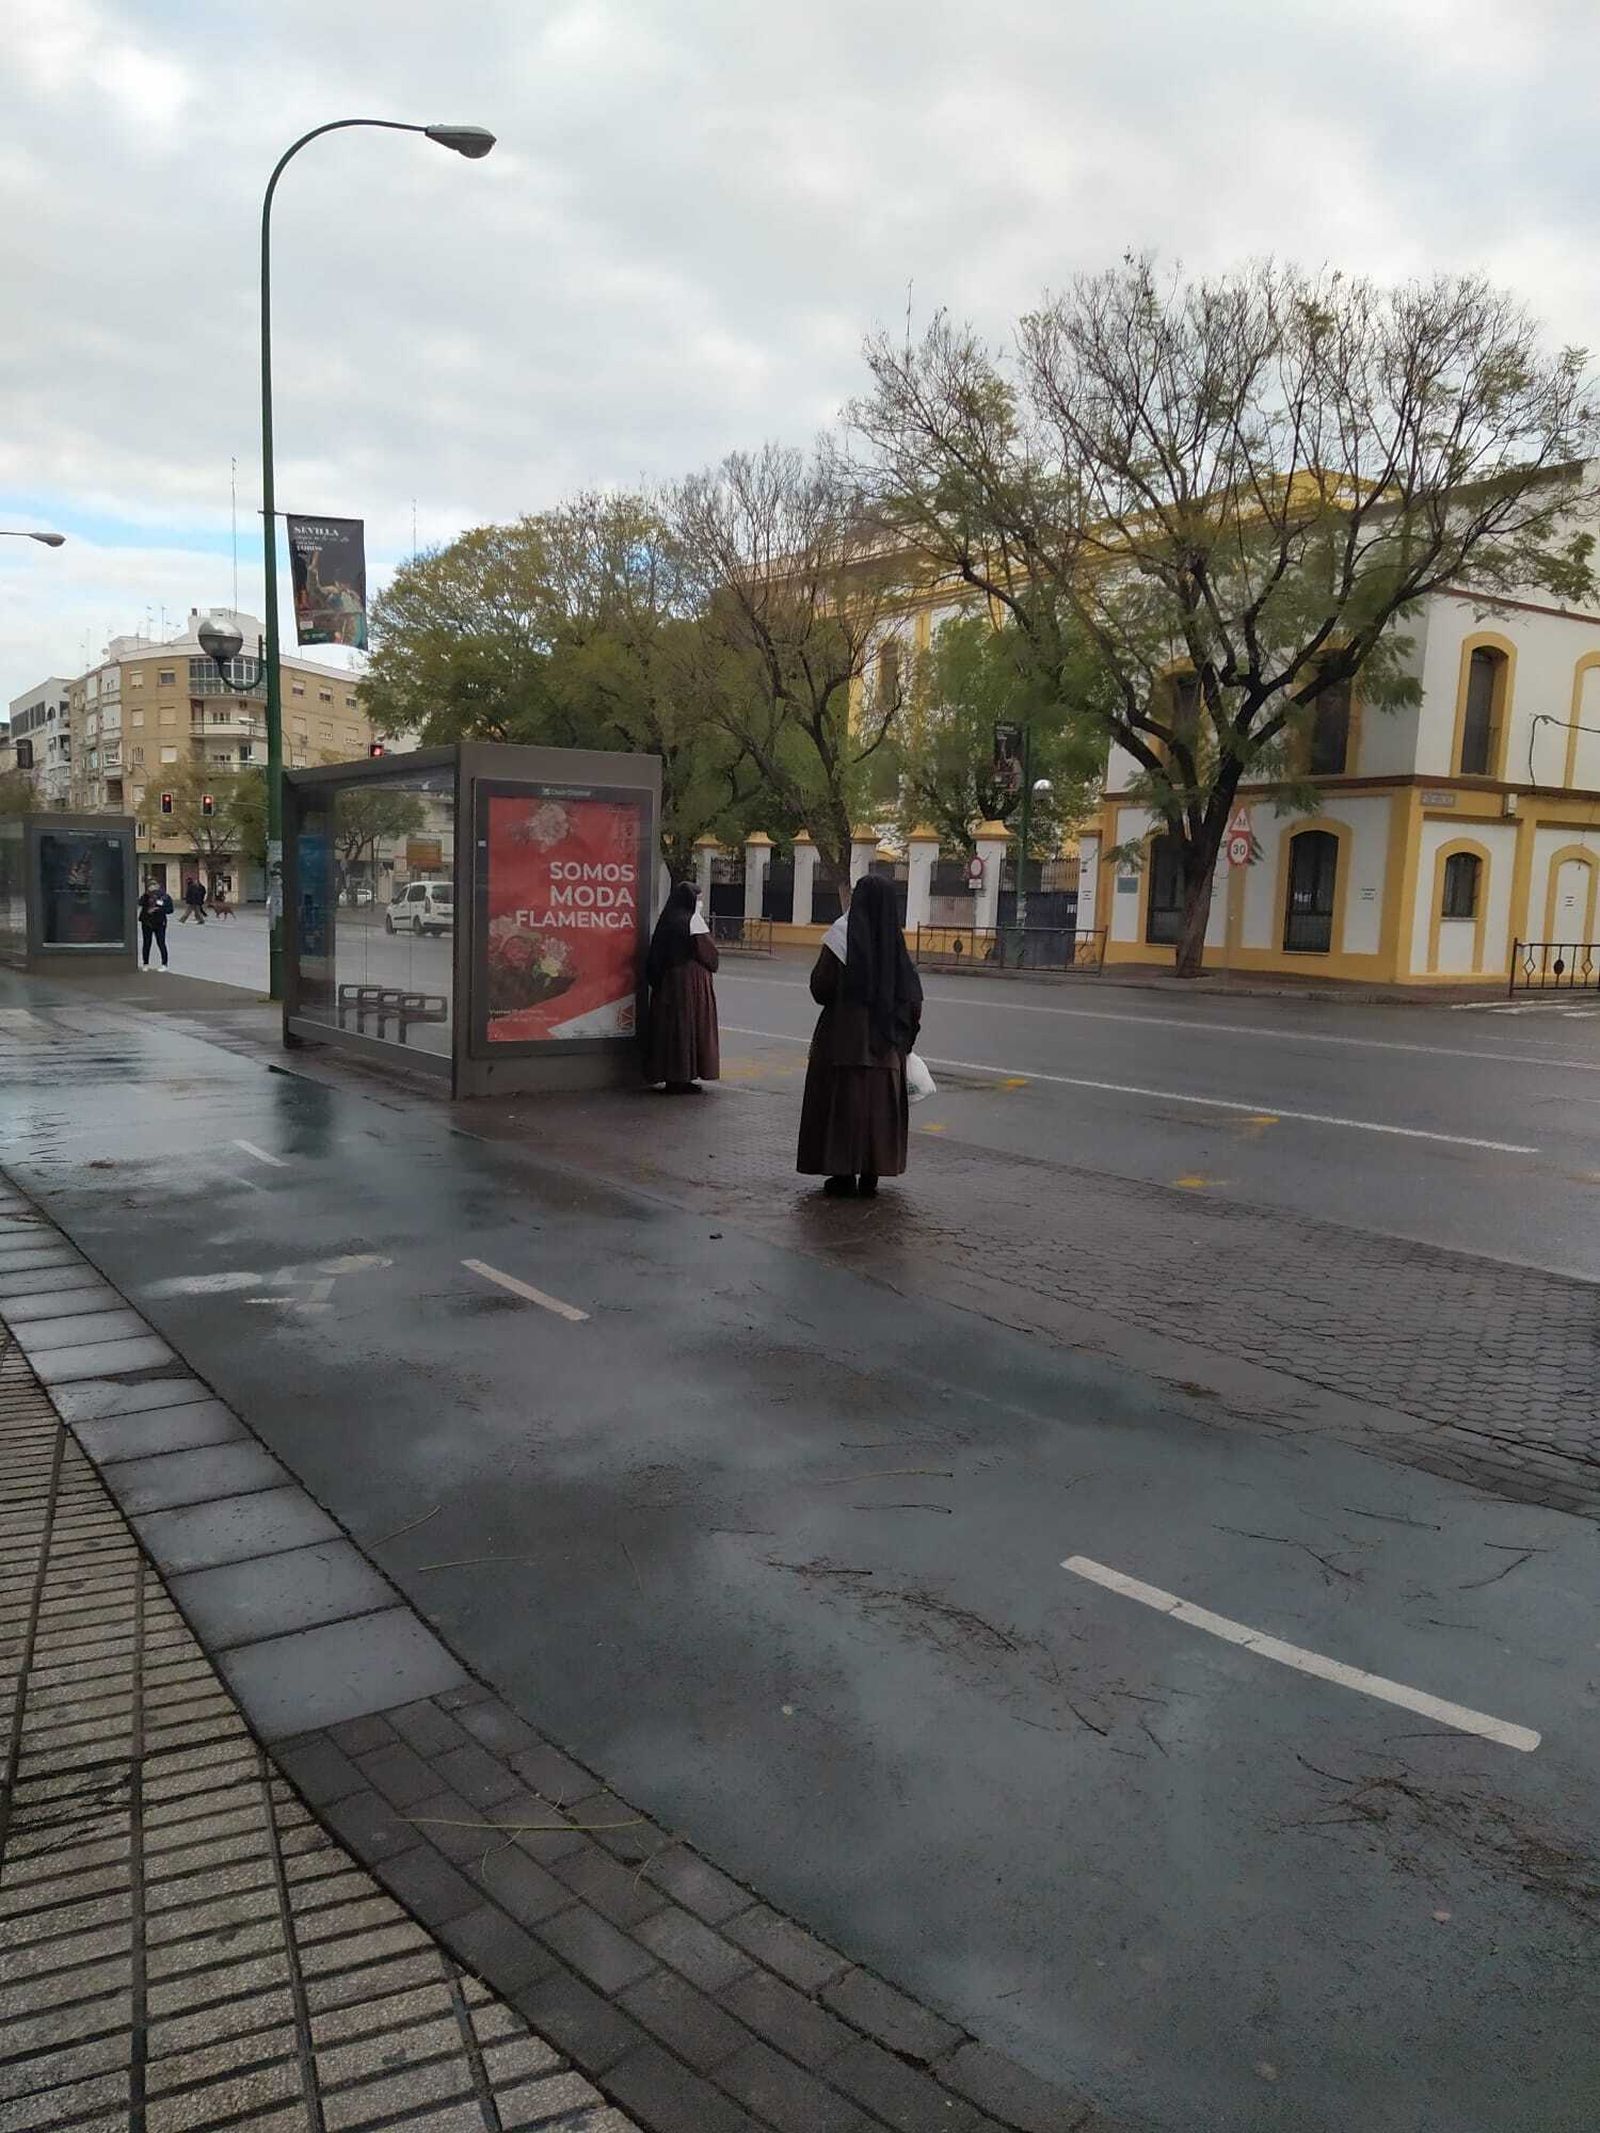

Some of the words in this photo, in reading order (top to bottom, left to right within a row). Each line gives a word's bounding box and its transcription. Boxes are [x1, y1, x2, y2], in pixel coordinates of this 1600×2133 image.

[293, 525, 340, 538] SEVILLA
[1233, 844, 1246, 855] 30
[549, 861, 635, 882] SOMOS
[549, 885, 635, 908] MODA
[516, 910, 634, 929] FLAMENCA
